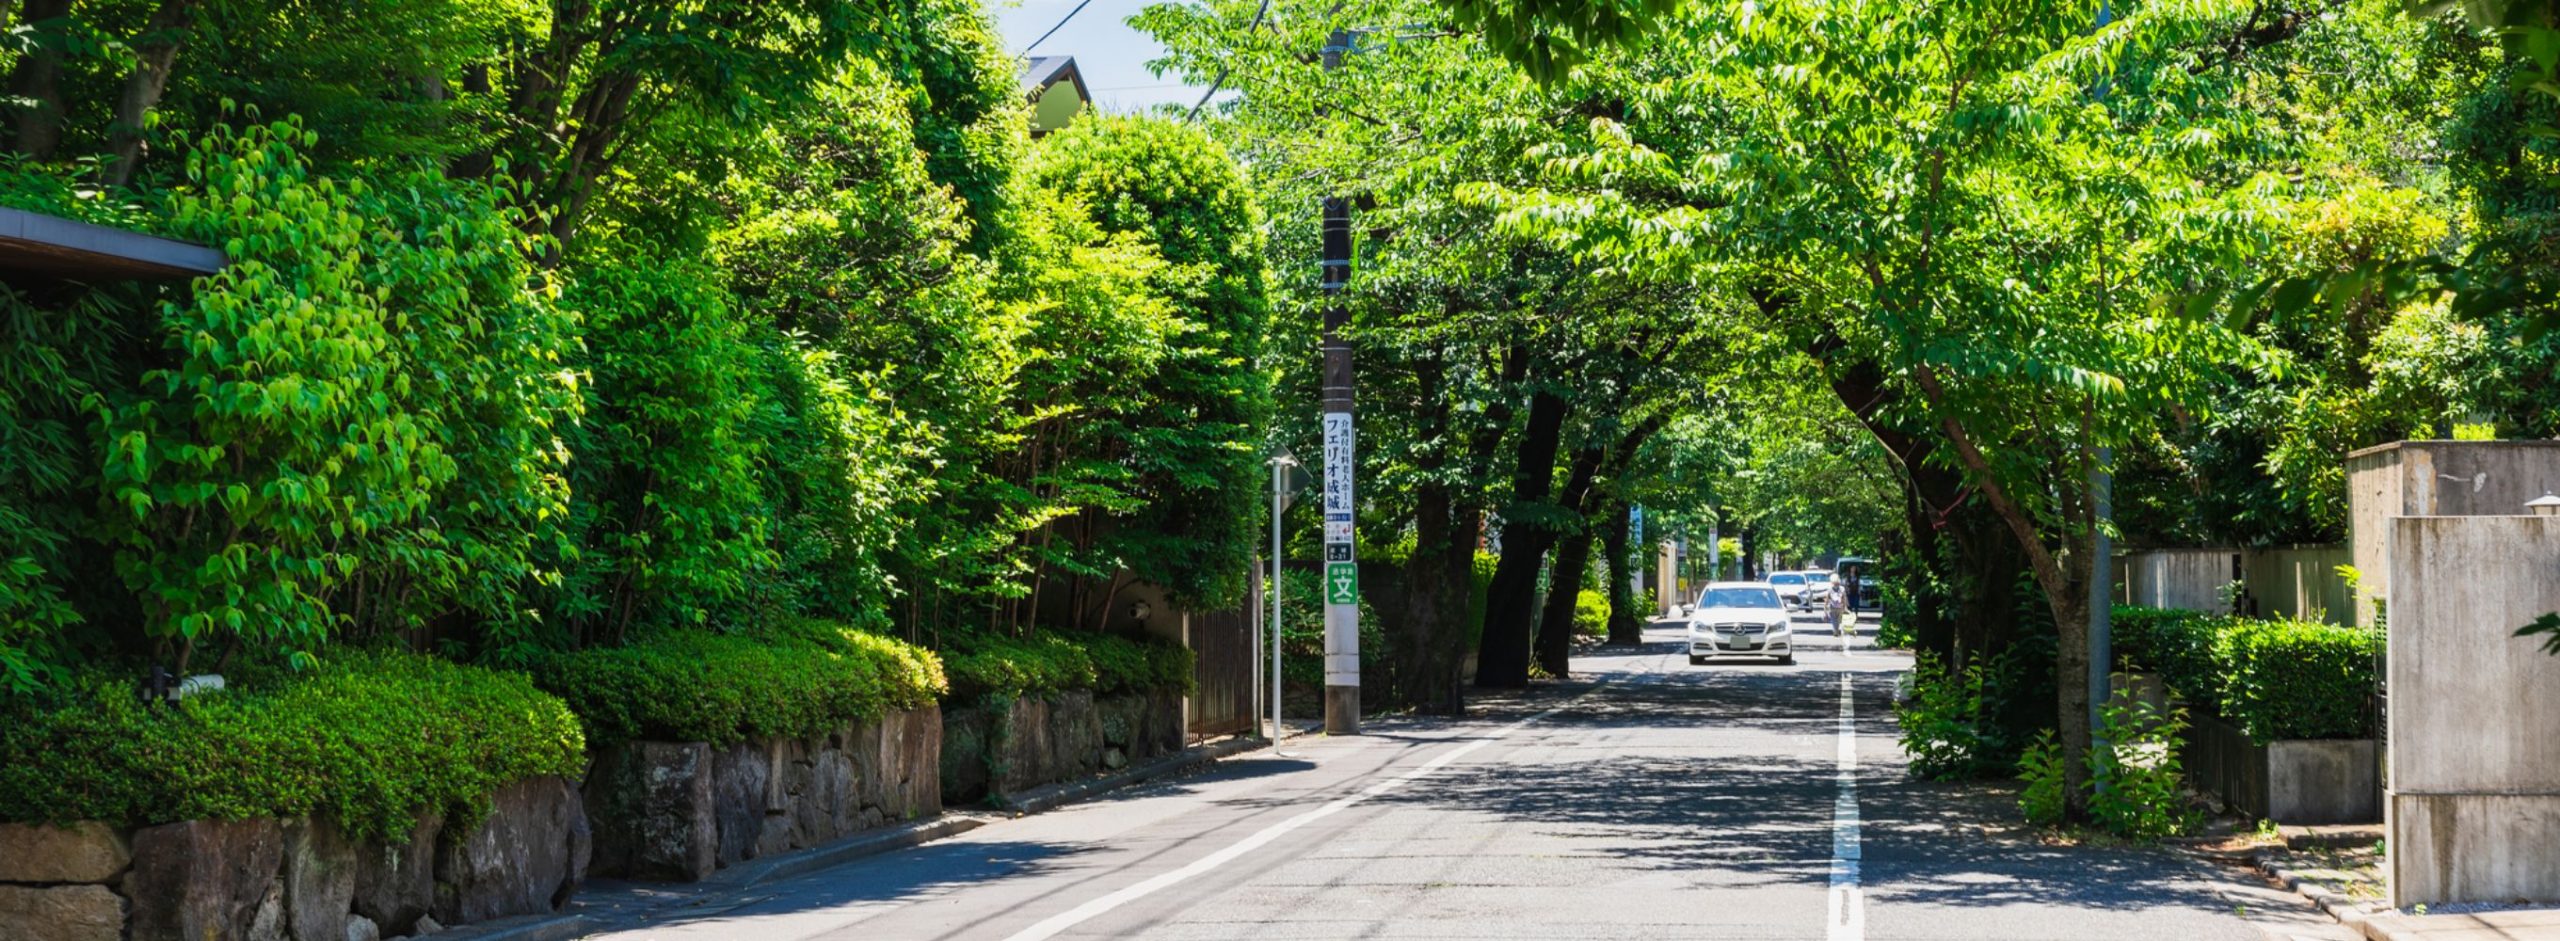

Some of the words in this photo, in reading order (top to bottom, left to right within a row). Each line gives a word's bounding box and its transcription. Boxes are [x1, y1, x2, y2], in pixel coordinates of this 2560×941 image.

[1327, 420, 1340, 510] フェリオ成城
[1333, 575, 1353, 597] 文
